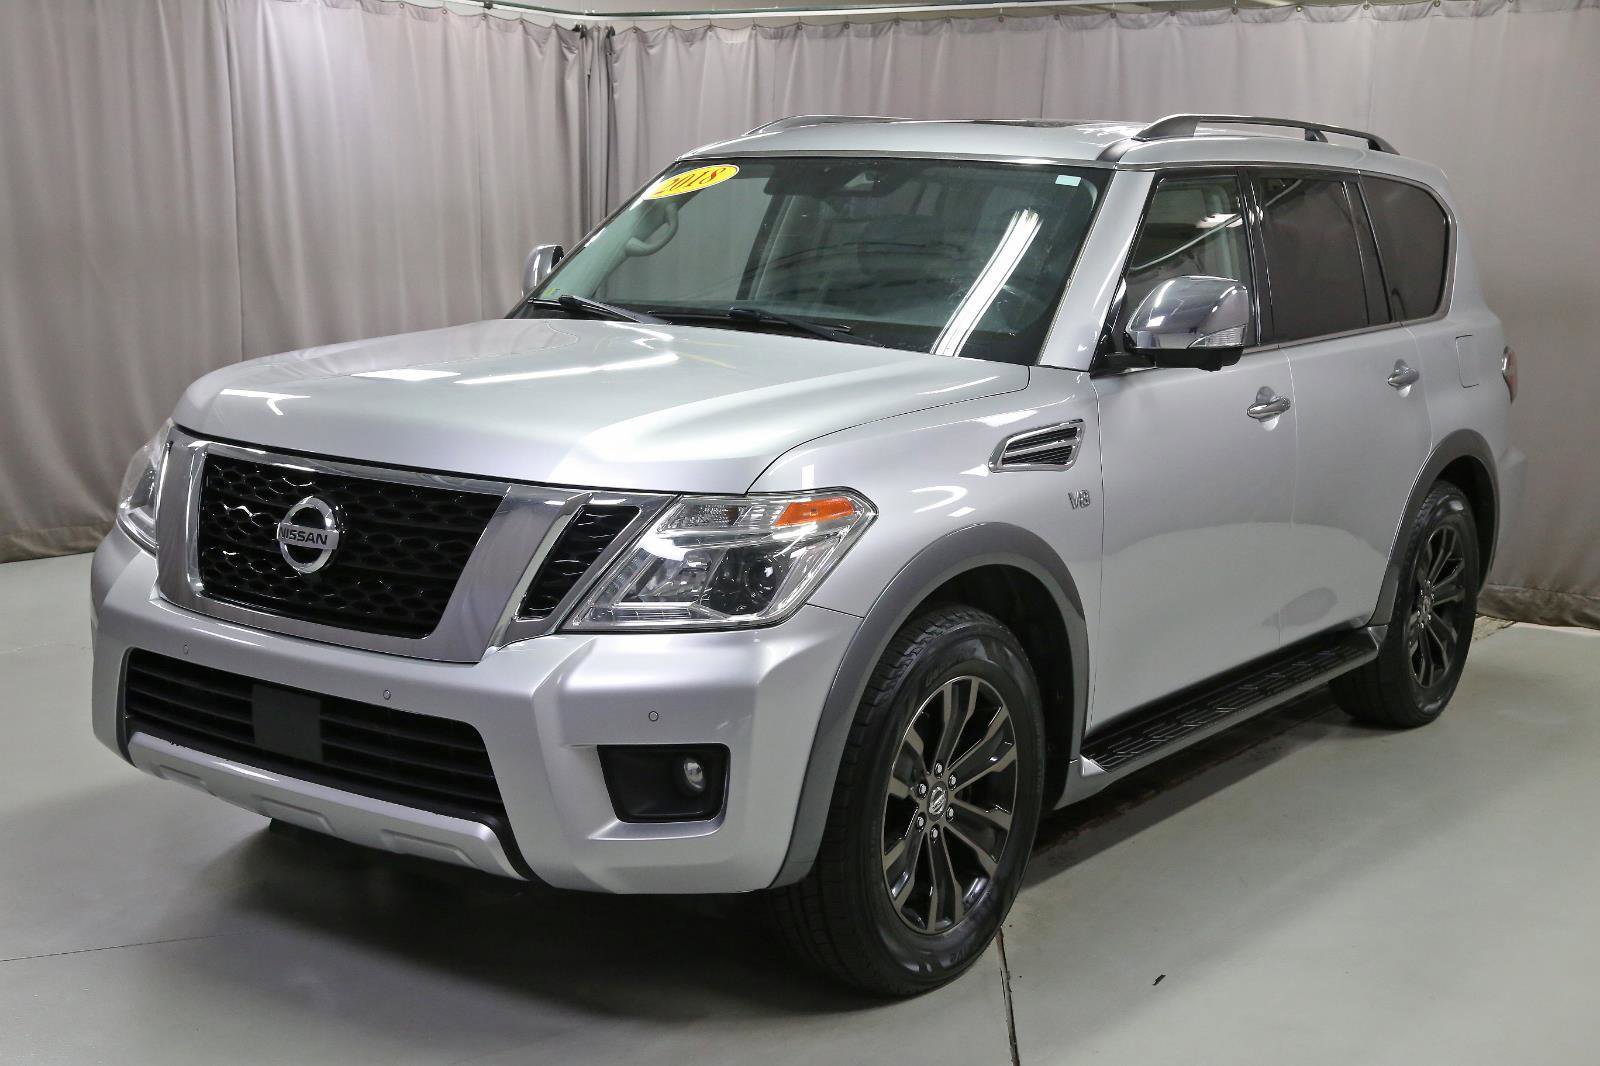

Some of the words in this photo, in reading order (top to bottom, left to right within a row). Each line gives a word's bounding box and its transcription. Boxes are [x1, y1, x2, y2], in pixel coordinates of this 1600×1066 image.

[654, 167, 728, 196] 2018
[1068, 489, 1091, 509] V8
[280, 526, 328, 545] NISSAN
